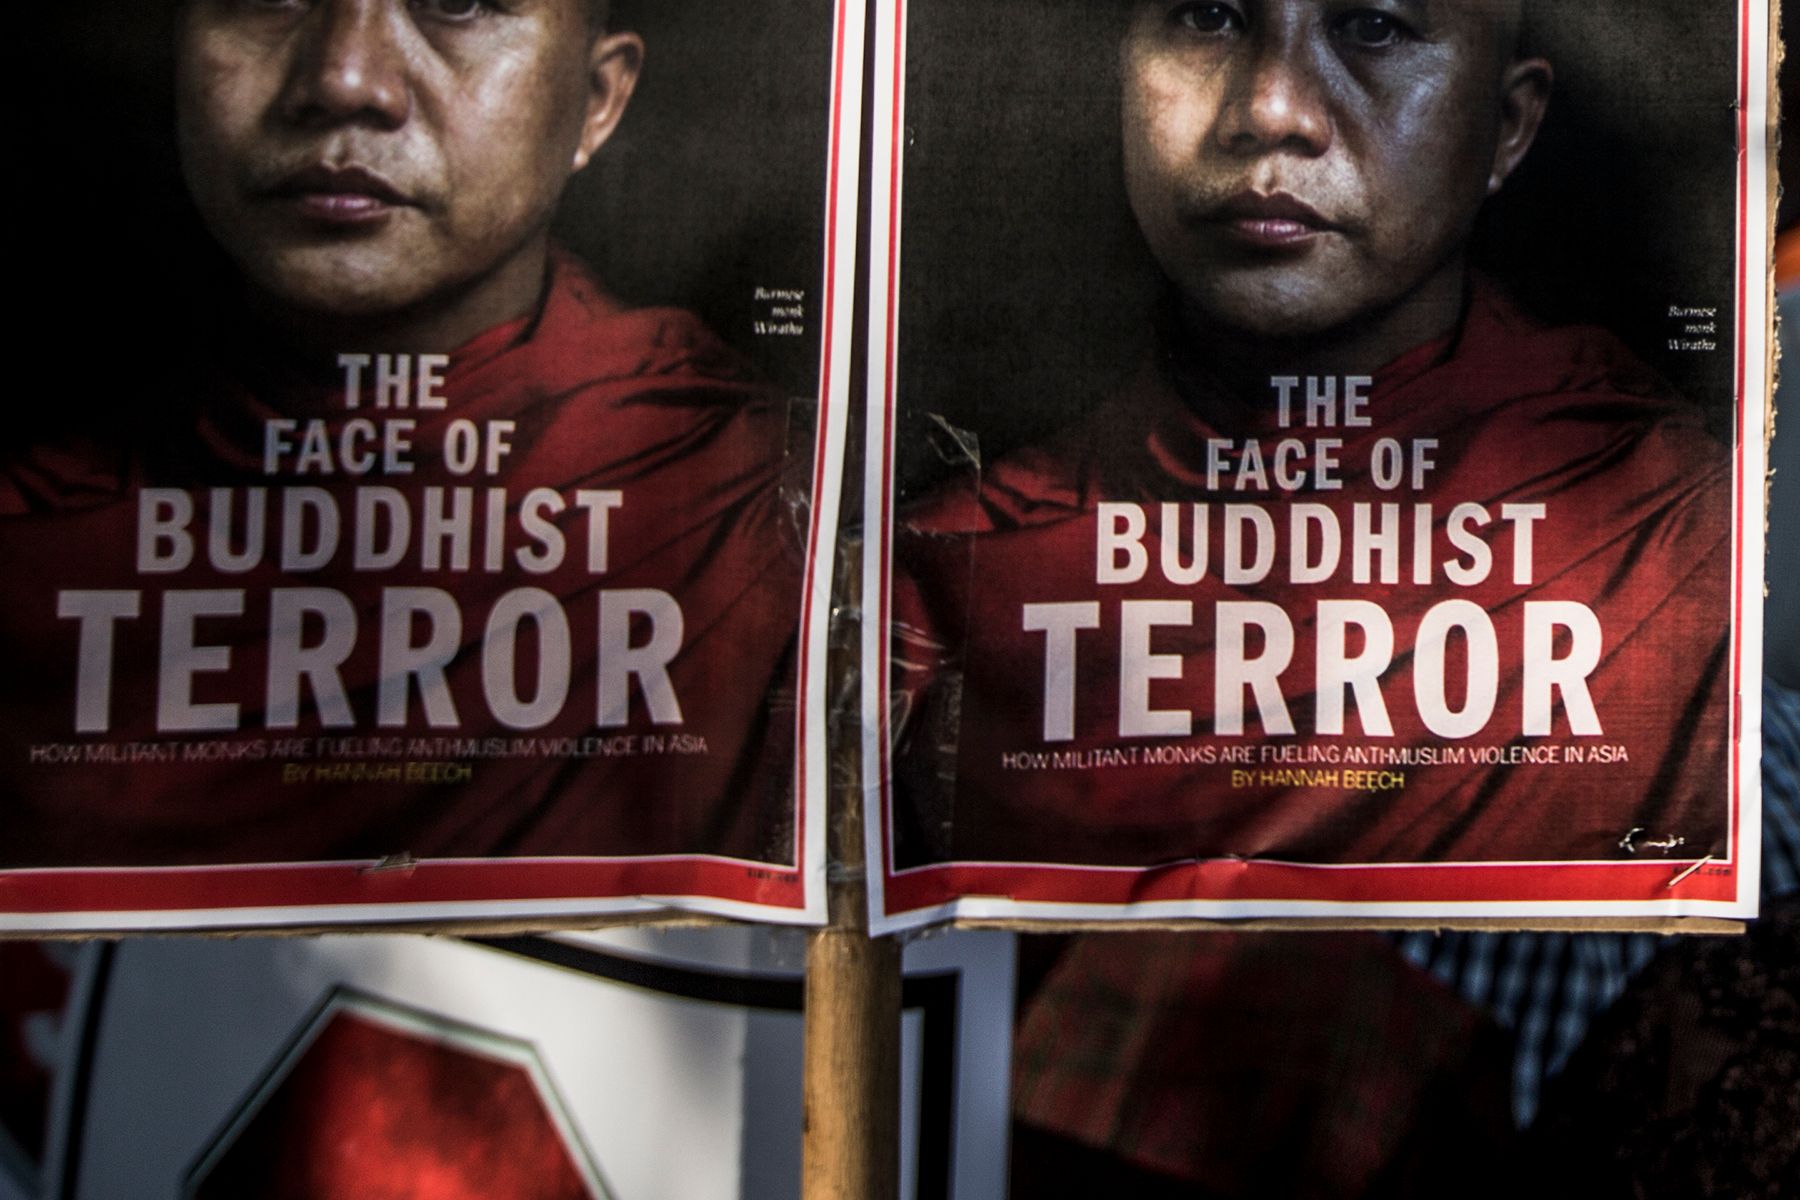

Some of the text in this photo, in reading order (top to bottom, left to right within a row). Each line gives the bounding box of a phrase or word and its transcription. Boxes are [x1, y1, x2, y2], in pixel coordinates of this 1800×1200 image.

[337, 354, 449, 408] THE
[1271, 375, 1373, 428] THE
[262, 418, 516, 475] FACE OF
[1206, 437, 1439, 491] FACE OF
[136, 487, 624, 575] BUDDHIST
[1096, 502, 1547, 586] BUDDHIST
[56, 587, 685, 733] TERROR
[1022, 600, 1604, 742] TERROR
[29, 744, 81, 763] HOW
[85, 742, 177, 763] MILITANT
[183, 739, 265, 762] MONKS
[269, 738, 312, 759] ARE
[316, 736, 402, 758] FUELING
[539, 736, 639, 758] VIOLENCE
[643, 735, 664, 756] IN
[668, 734, 709, 754] ASIA
[282, 761, 473, 784] BY HANNAH BEECH
[1002, 744, 1629, 770] HOW MILITANT MONKS ARE FUELING ANTI-MUSLIM VIOLENCE IN ASIA
[1231, 769, 1404, 789] BY HANNAH BEECH
